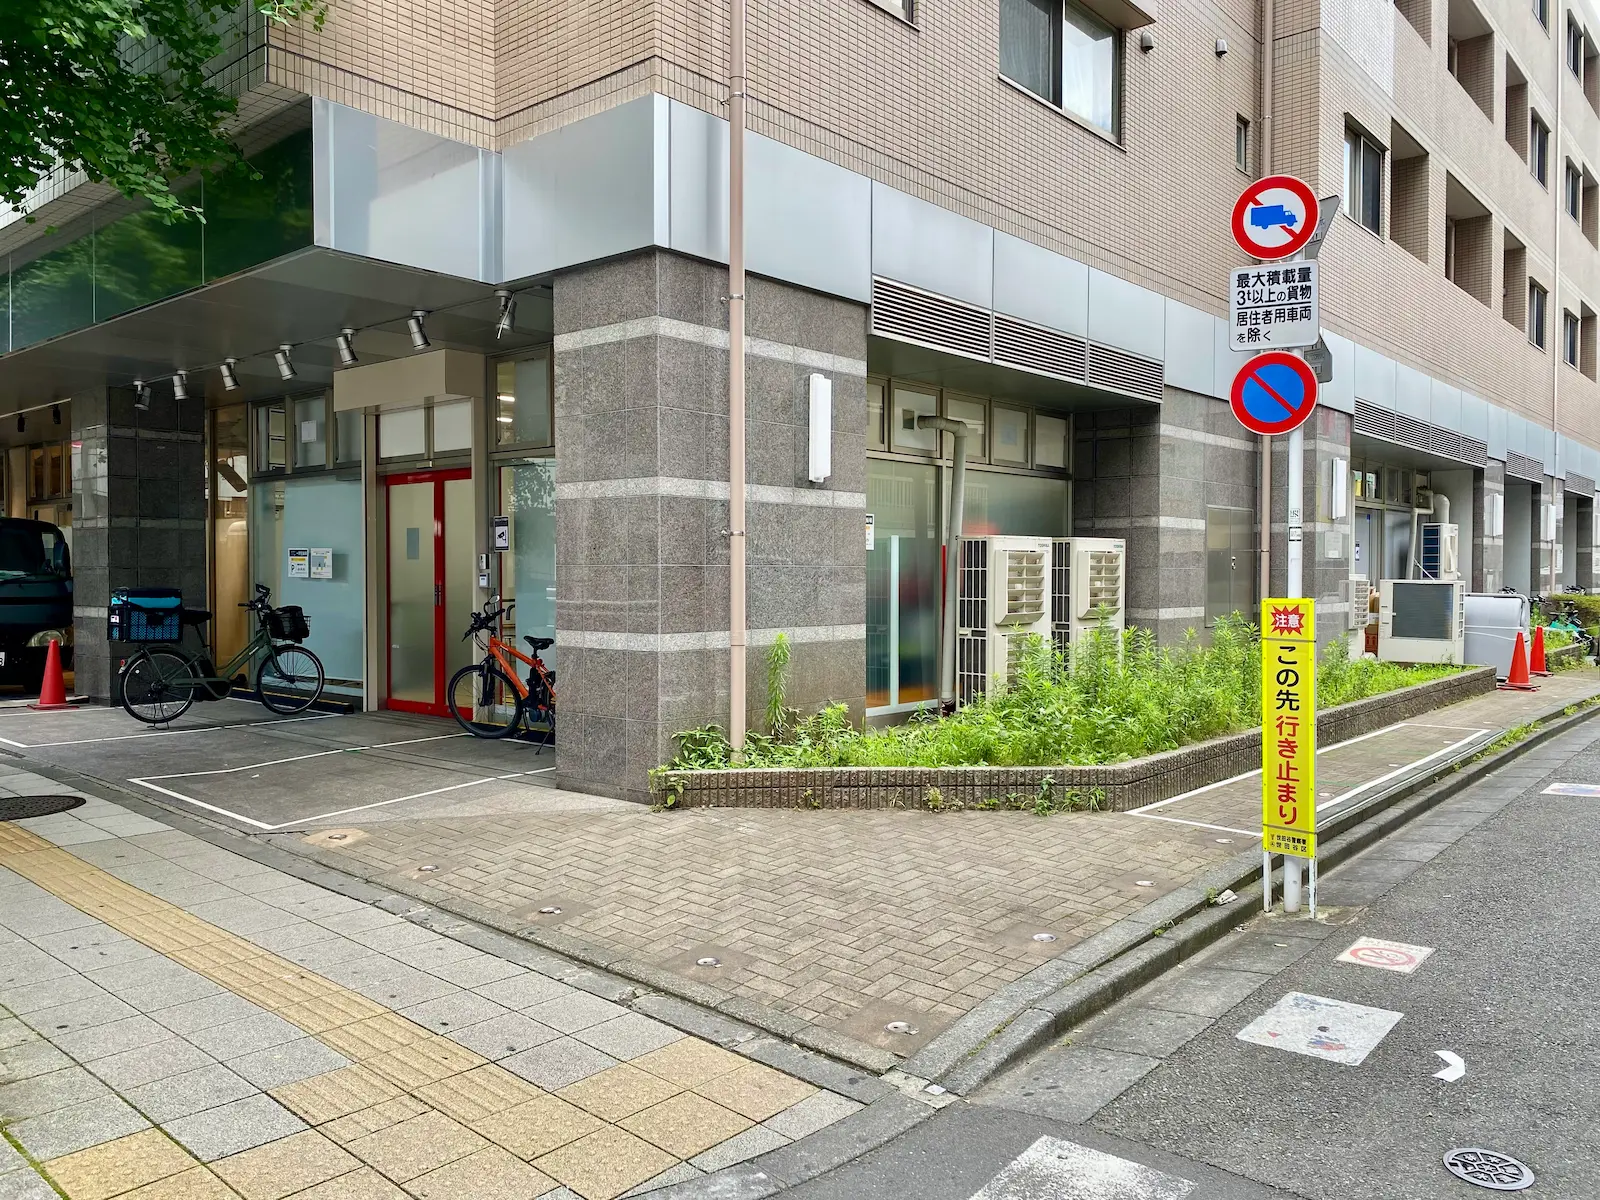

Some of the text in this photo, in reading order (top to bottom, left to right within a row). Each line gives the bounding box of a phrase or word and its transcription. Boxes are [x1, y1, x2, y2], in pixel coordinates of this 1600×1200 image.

[1236, 267, 1312, 288] 最大積載量
[1236, 284, 1312, 305] 3t以上の貨物
[1236, 305, 1312, 327] 居住者用車両
[1236, 327, 1271, 343] を除く
[1275, 613, 1300, 629] 注意
